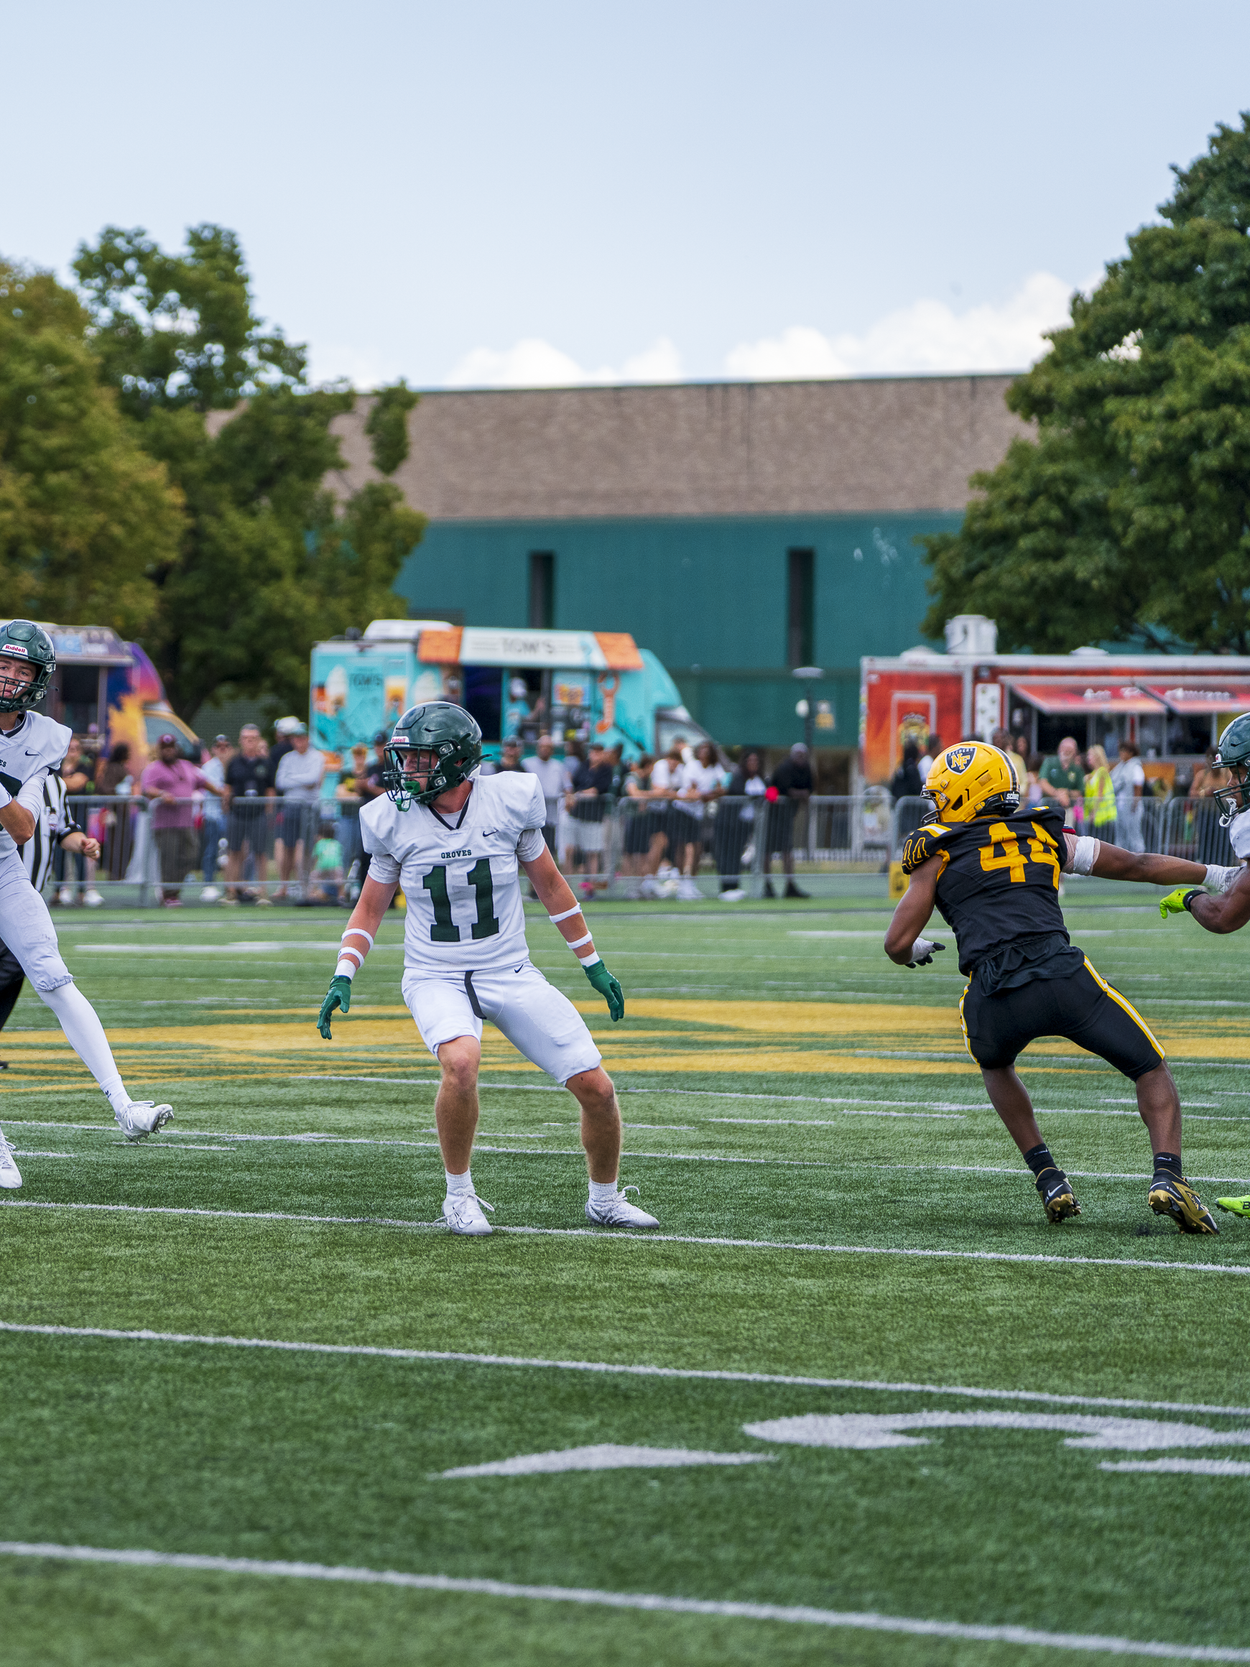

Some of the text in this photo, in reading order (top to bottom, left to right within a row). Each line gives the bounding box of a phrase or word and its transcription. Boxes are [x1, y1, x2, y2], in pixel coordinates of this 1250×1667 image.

[5, 644, 26, 654] Riddell
[950, 753, 970, 770] NF
[440, 849, 472, 859] GROVES
[978, 821, 1059, 891] 44
[422, 857, 500, 943] 11
